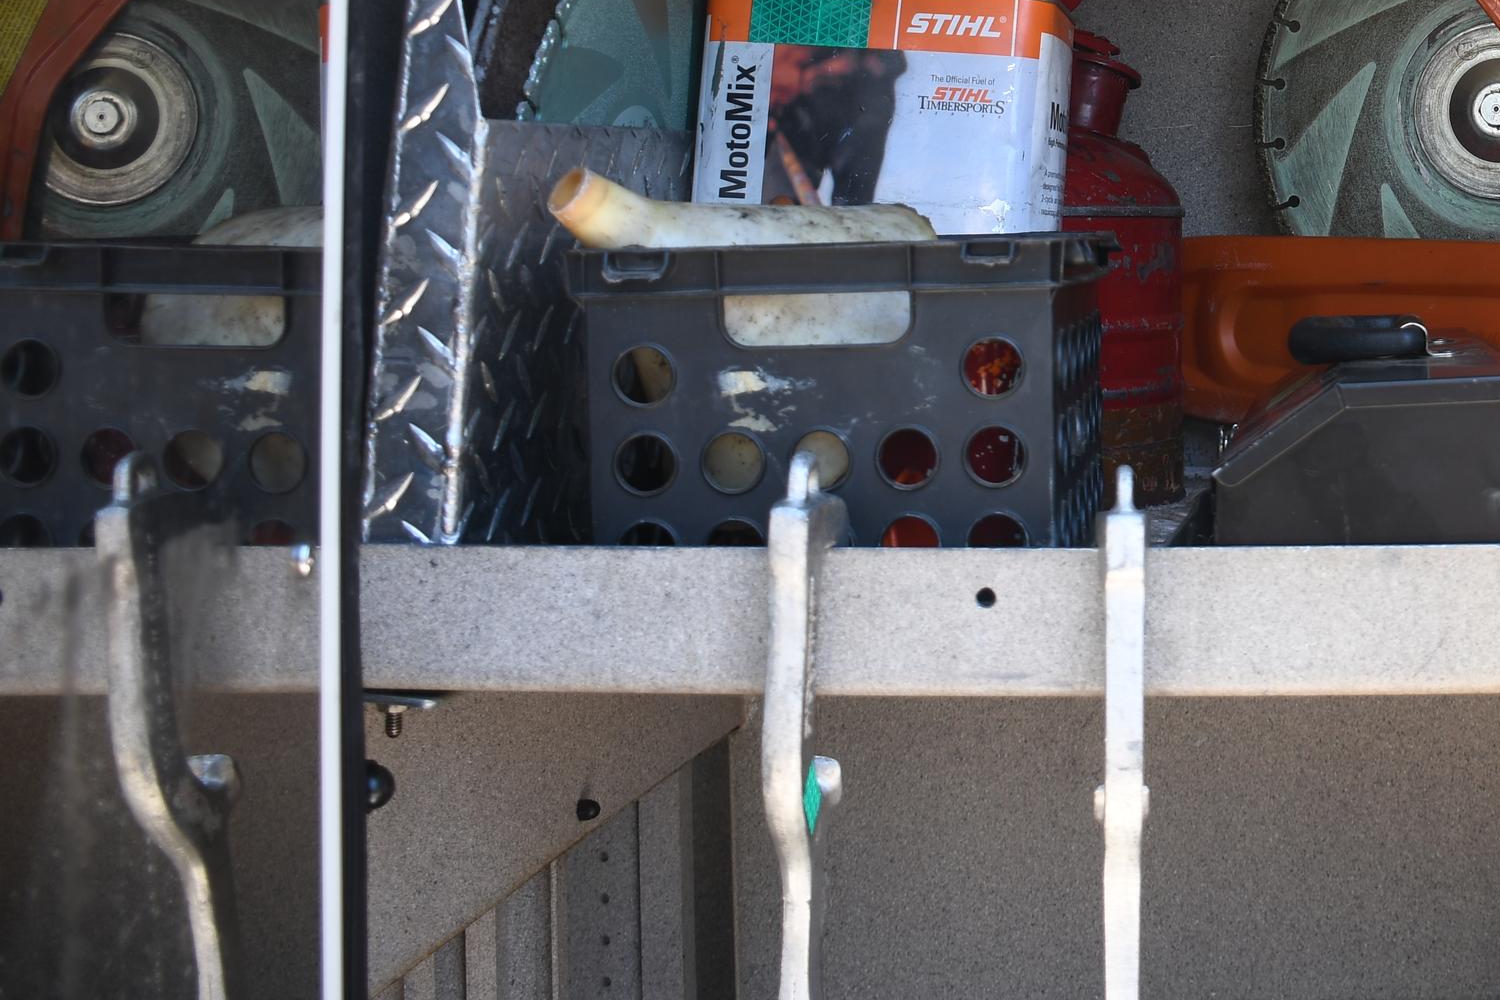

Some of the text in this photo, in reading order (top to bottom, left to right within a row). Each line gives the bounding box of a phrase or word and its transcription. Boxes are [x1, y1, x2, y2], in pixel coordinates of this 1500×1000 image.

[906, 13, 1001, 38] STIHL
[931, 74, 996, 86] The Official Fuel of
[932, 86, 993, 103] STIHL
[718, 64, 757, 199] MotoMix
